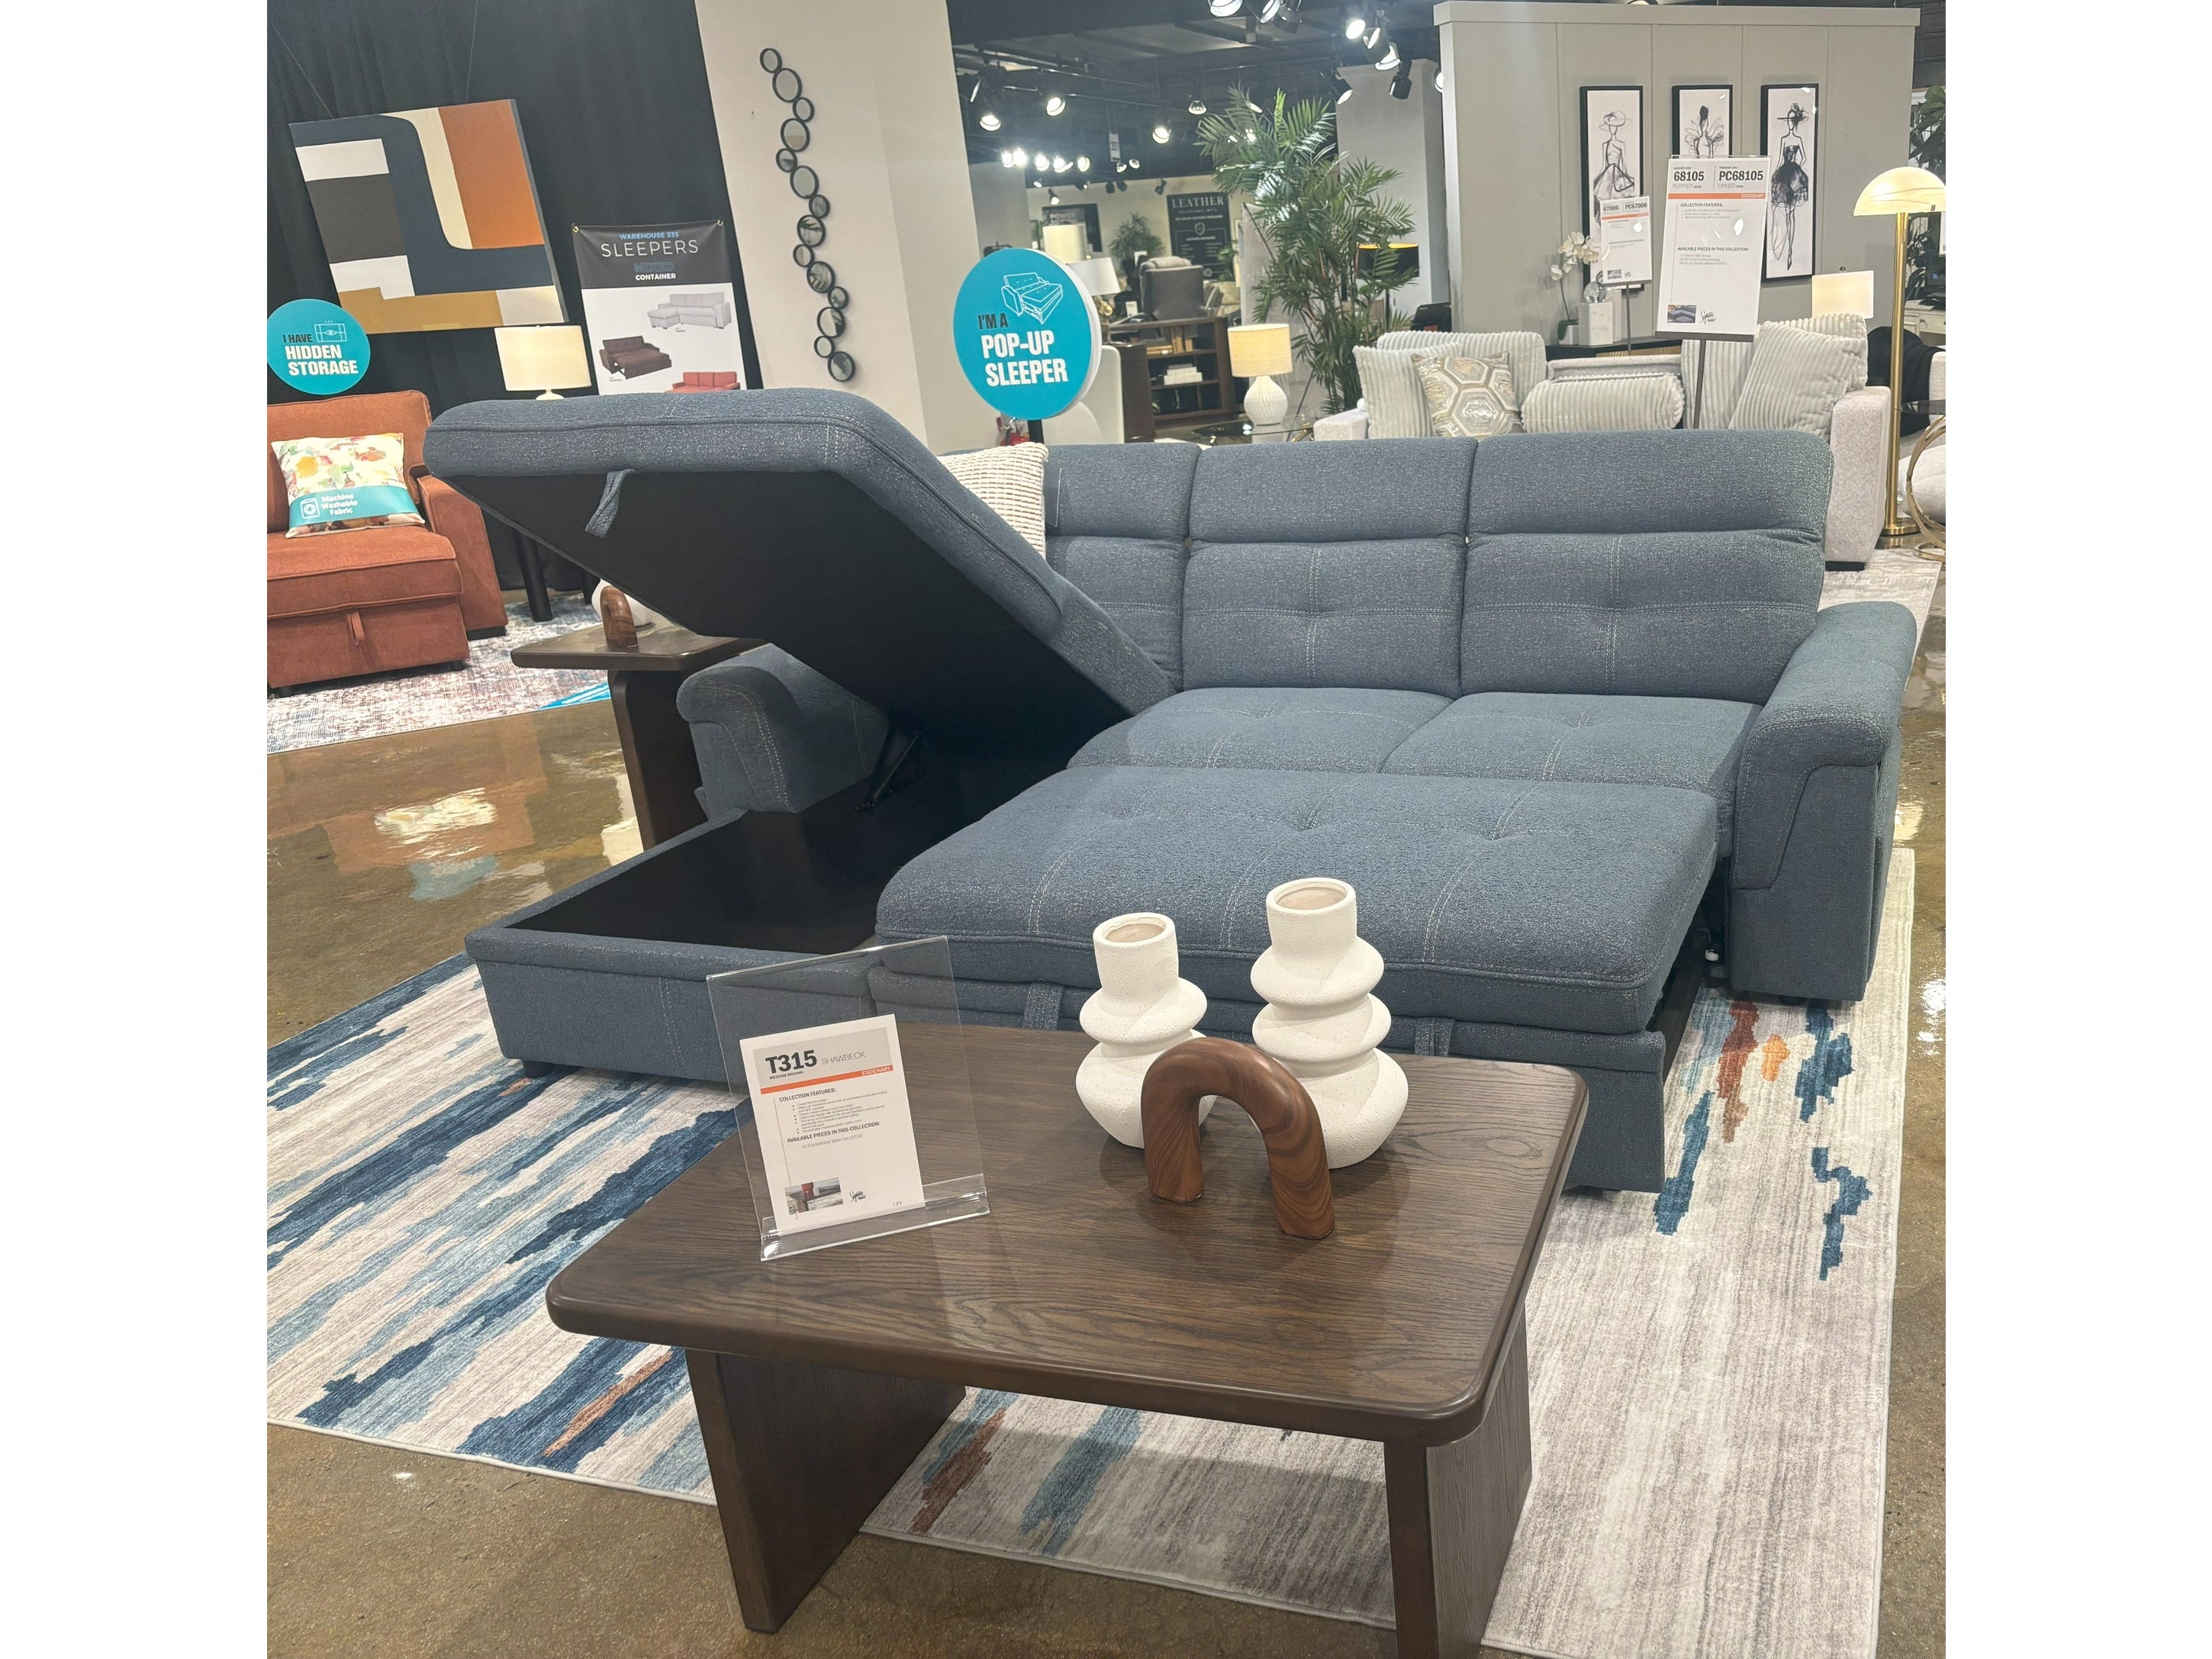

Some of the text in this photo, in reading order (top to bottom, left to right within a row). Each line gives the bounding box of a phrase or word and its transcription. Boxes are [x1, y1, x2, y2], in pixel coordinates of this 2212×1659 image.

[1673, 171, 1705, 181] 68105
[1719, 170, 1763, 181] PC68105
[1172, 196, 1224, 208] LEATHER
[619, 231, 665, 240] WAREHOUSE
[600, 239, 699, 258] SLEEPERS
[977, 313, 1009, 330] I'M A
[282, 333, 313, 343] I HAVE
[980, 330, 1054, 359] POP-UP
[285, 344, 342, 359] HIDDEN
[288, 360, 359, 375] STORAGE
[985, 358, 1068, 387] SLEEPER
[321, 494, 354, 502] Machine
[320, 500, 358, 510] Washable
[330, 507, 353, 516] Fabric
[765, 1049, 866, 1074] T315 SHAWBECK
[861, 1066, 890, 1076] STATIONARY
[779, 1087, 837, 1102] COLLECTION FEATURES:
[787, 1133, 813, 1143] AVAILABLE
[849, 1121, 881, 1132] COLLECTION:
